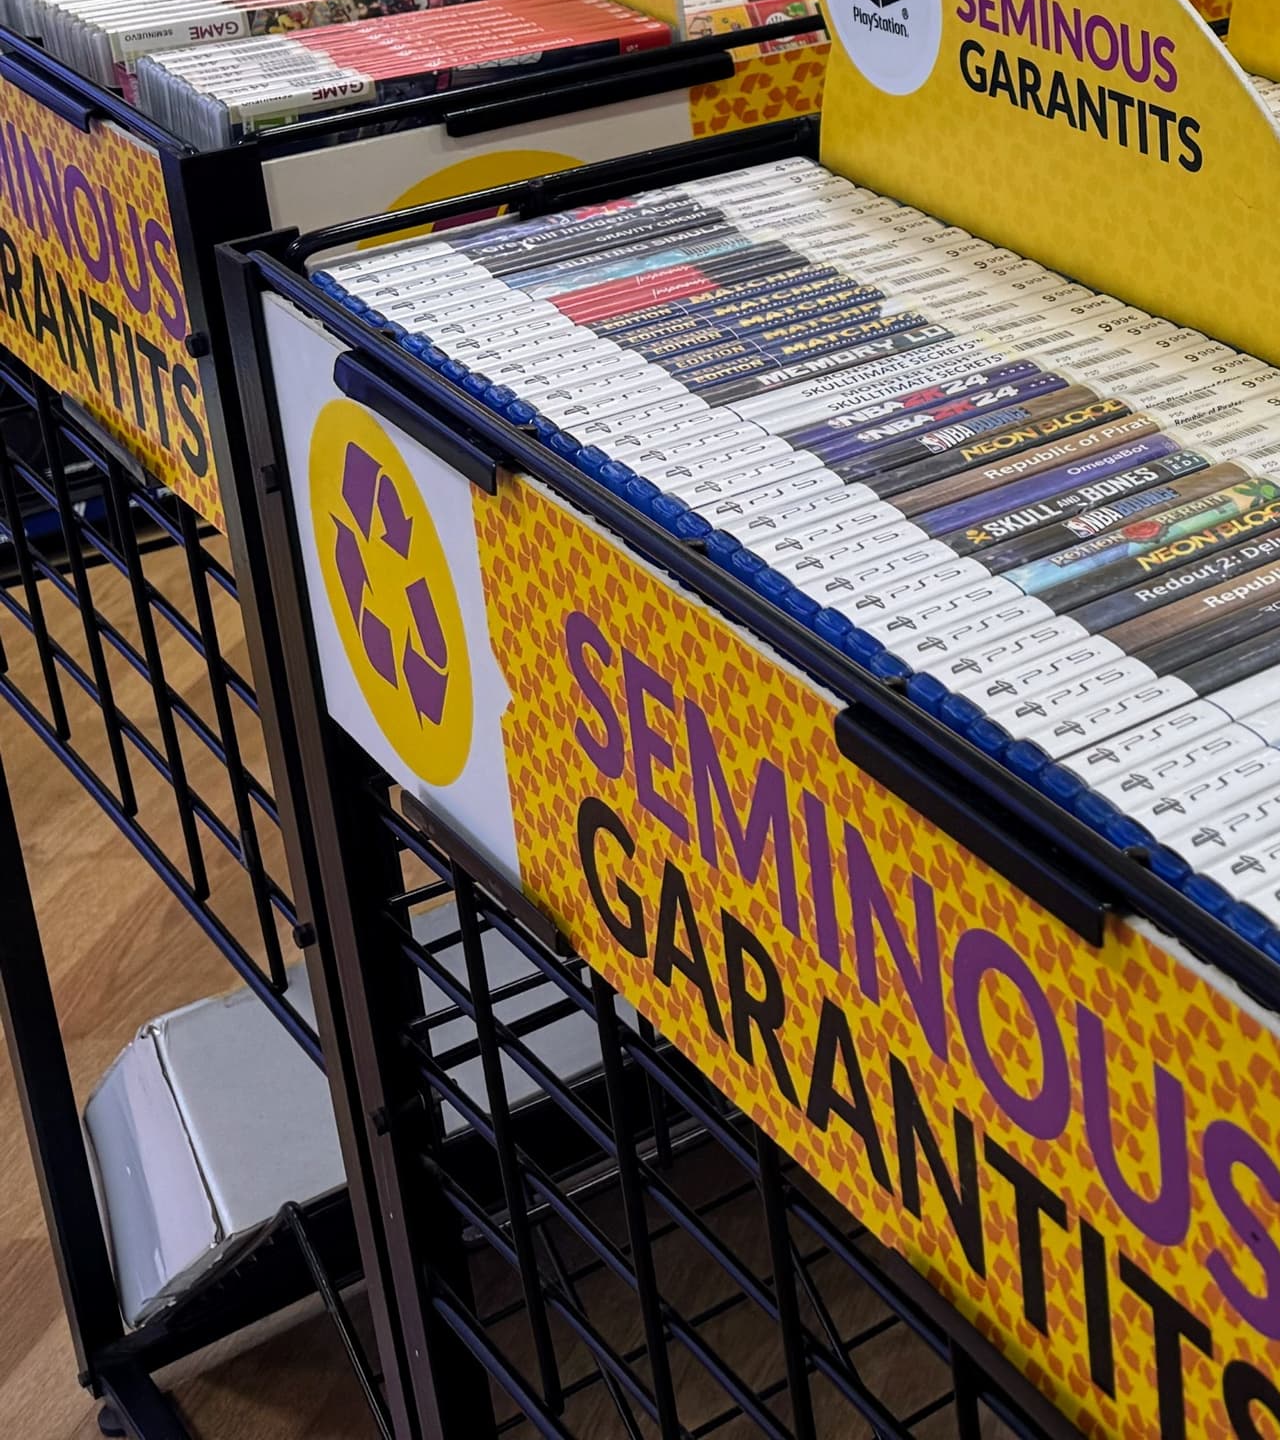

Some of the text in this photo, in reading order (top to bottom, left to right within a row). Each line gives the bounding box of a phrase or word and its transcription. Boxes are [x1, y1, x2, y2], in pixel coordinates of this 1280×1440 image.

[190, 20, 240, 41] GAME
[852, 6, 909, 38] PlayStation
[959, 39, 1202, 174] GARANTITS
[5, 121, 187, 341] INOUS
[0, 225, 208, 477] RANTITS
[757, 340, 893, 386] MEMORY
[1066, 444, 1150, 477] OmegaBot
[988, 467, 1159, 539] SKULL AND BONES
[1138, 530, 1213, 572] NEON
[1135, 565, 1213, 603] Redout
[1218, 553, 1242, 578] 2:
